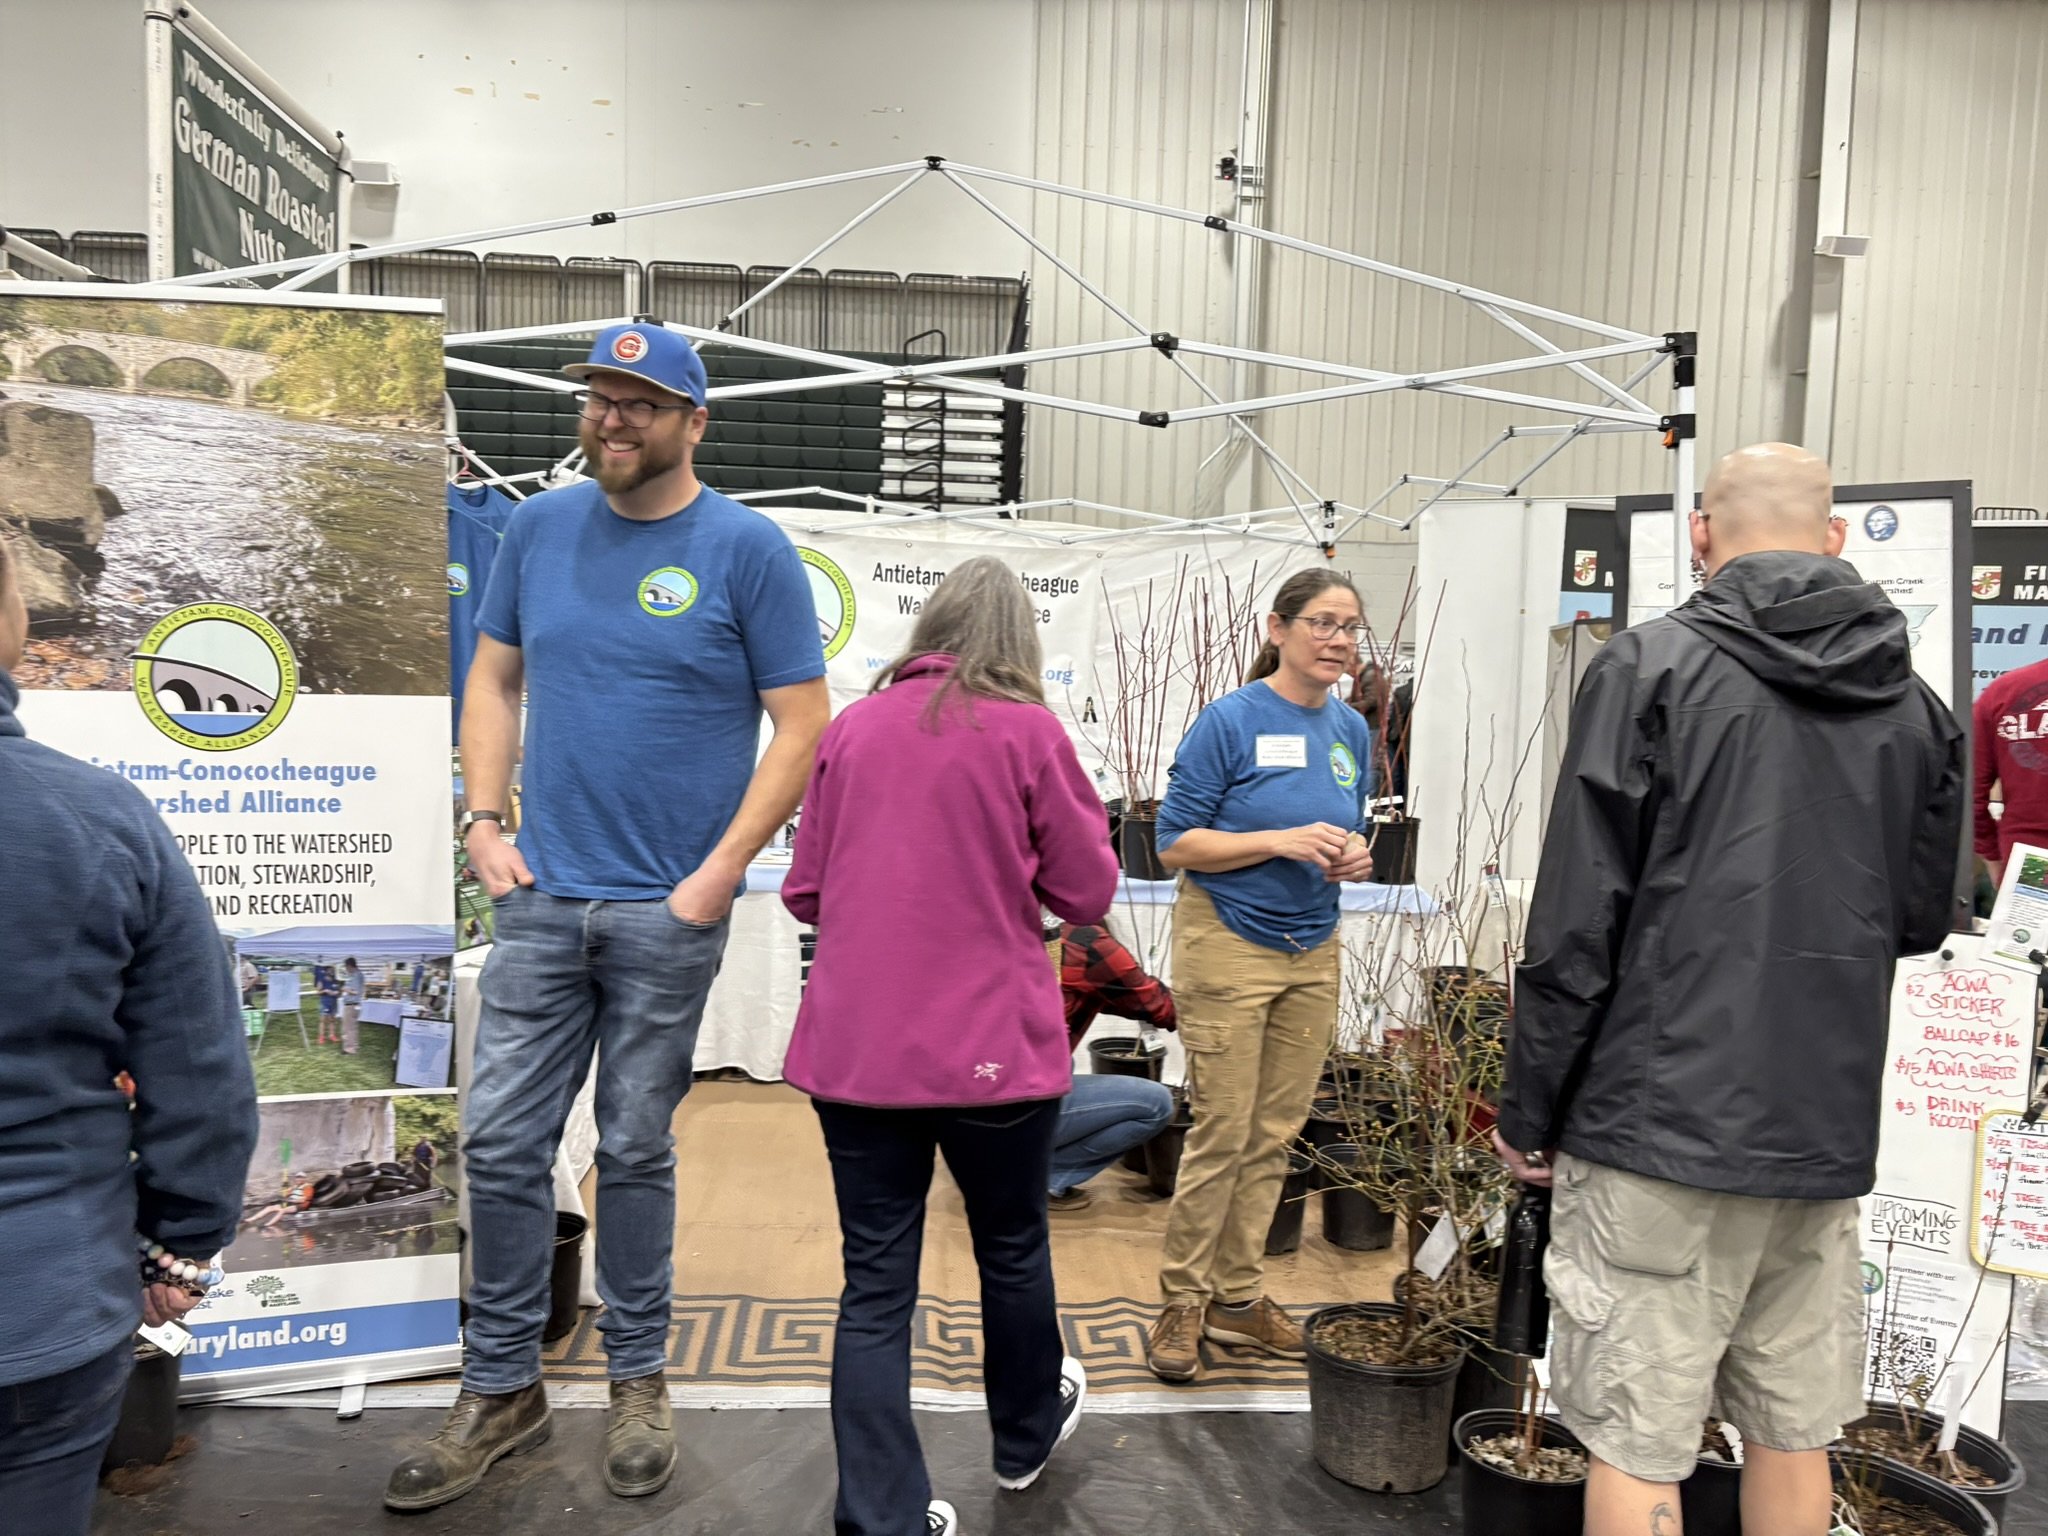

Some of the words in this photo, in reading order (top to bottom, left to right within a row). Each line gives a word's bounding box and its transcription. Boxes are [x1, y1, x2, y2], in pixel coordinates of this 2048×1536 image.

[183, 49, 272, 152] Wonderfully
[275, 127, 331, 193] Delicious
[175, 96, 261, 206] German
[265, 165, 336, 254] Roasted
[238, 207, 286, 279] Nuts
[137, 676, 197, 744] WATERSHED
[204, 721, 274, 748] ALLIANCE
[239, 791, 342, 813] Alliance
[224, 834, 247, 855] TO
[253, 834, 287, 855] THE
[291, 833, 393, 854] WATERSHED
[253, 864, 376, 888] STEWARDSHIP,
[248, 893, 353, 915] RECREATION
[1942, 974, 1993, 994] ACWA
[1926, 993, 2006, 1017] STICKER
[1923, 1026, 1989, 1046] BALLCAP
[1926, 1058, 1969, 1079] ACWA
[1927, 1095, 1985, 1115] DRINK
[1872, 1198, 1961, 1229] UPCOMING
[1871, 1219, 1951, 1245] EVENTS
[1930, 1317, 1958, 1328] Events
